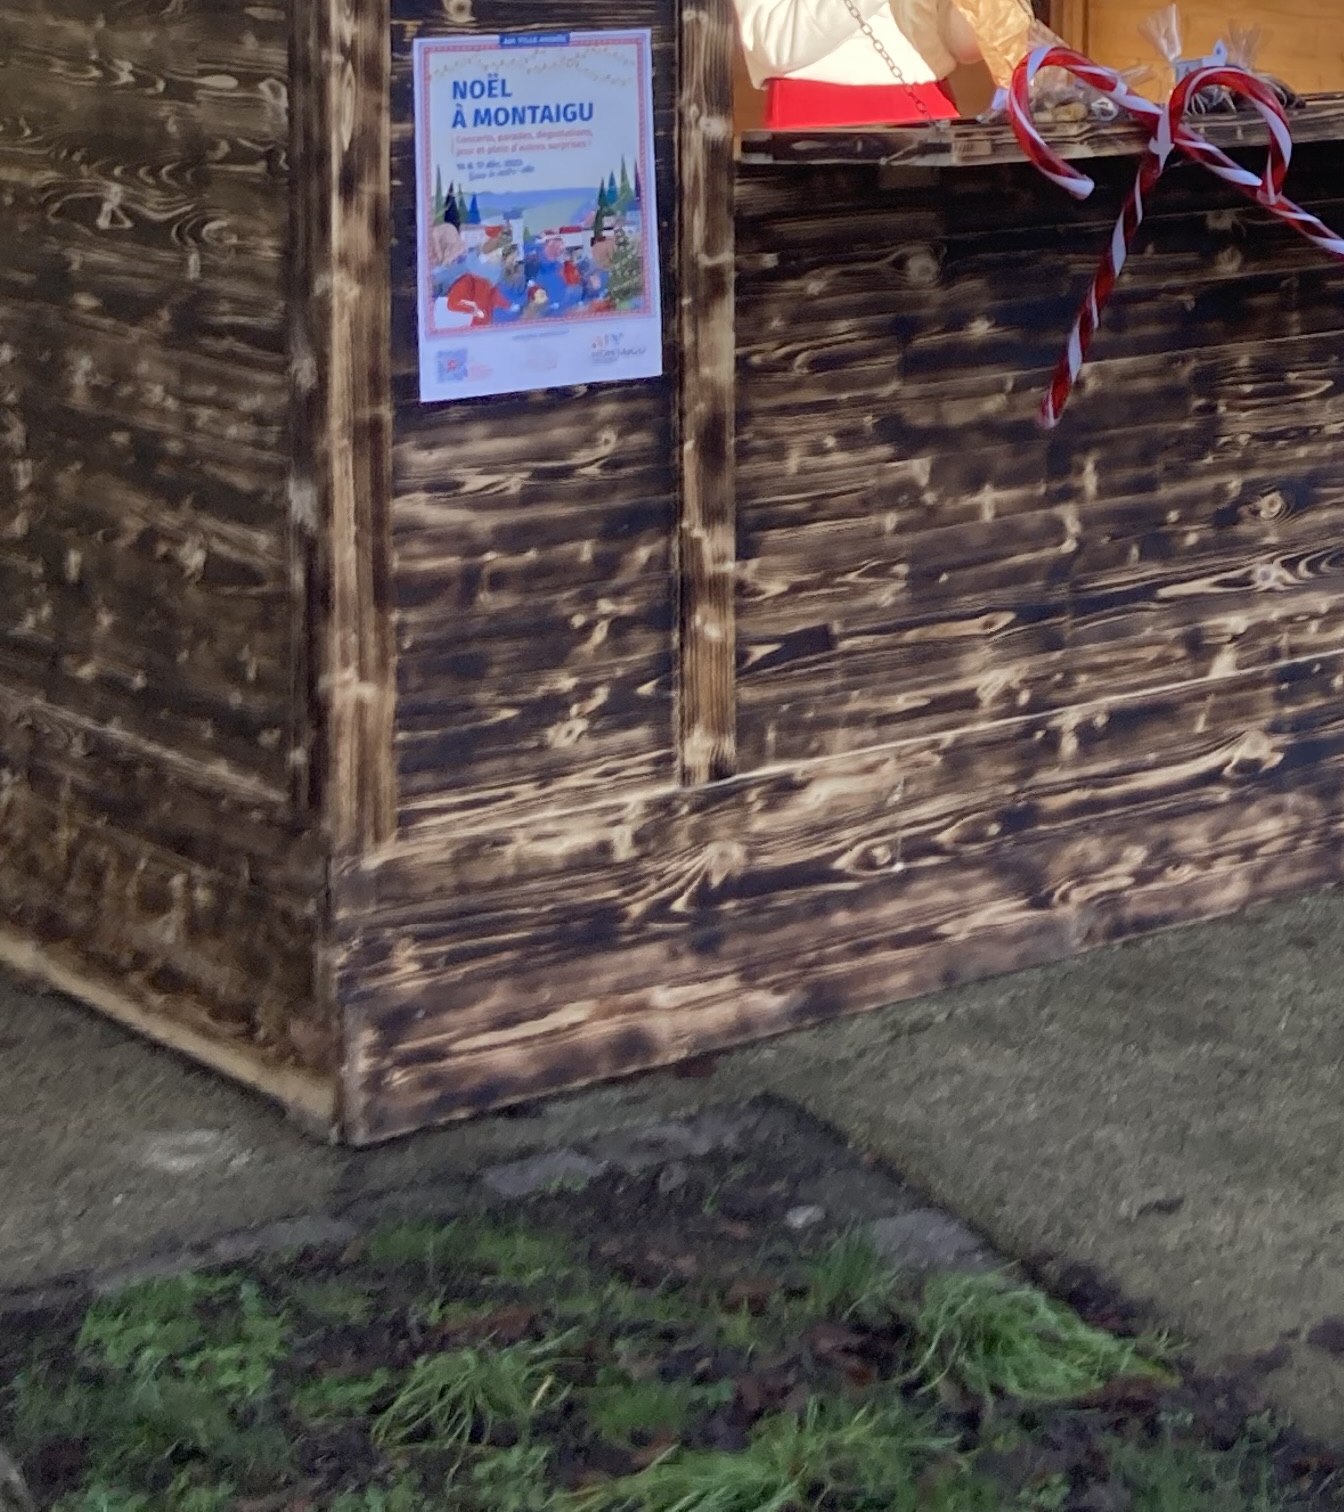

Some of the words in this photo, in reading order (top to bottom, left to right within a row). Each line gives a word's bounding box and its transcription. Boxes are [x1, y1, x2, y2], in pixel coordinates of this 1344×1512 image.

[452, 72, 513, 100] NOËL
[452, 103, 467, 129] À
[472, 102, 594, 128] MONTAIGU
